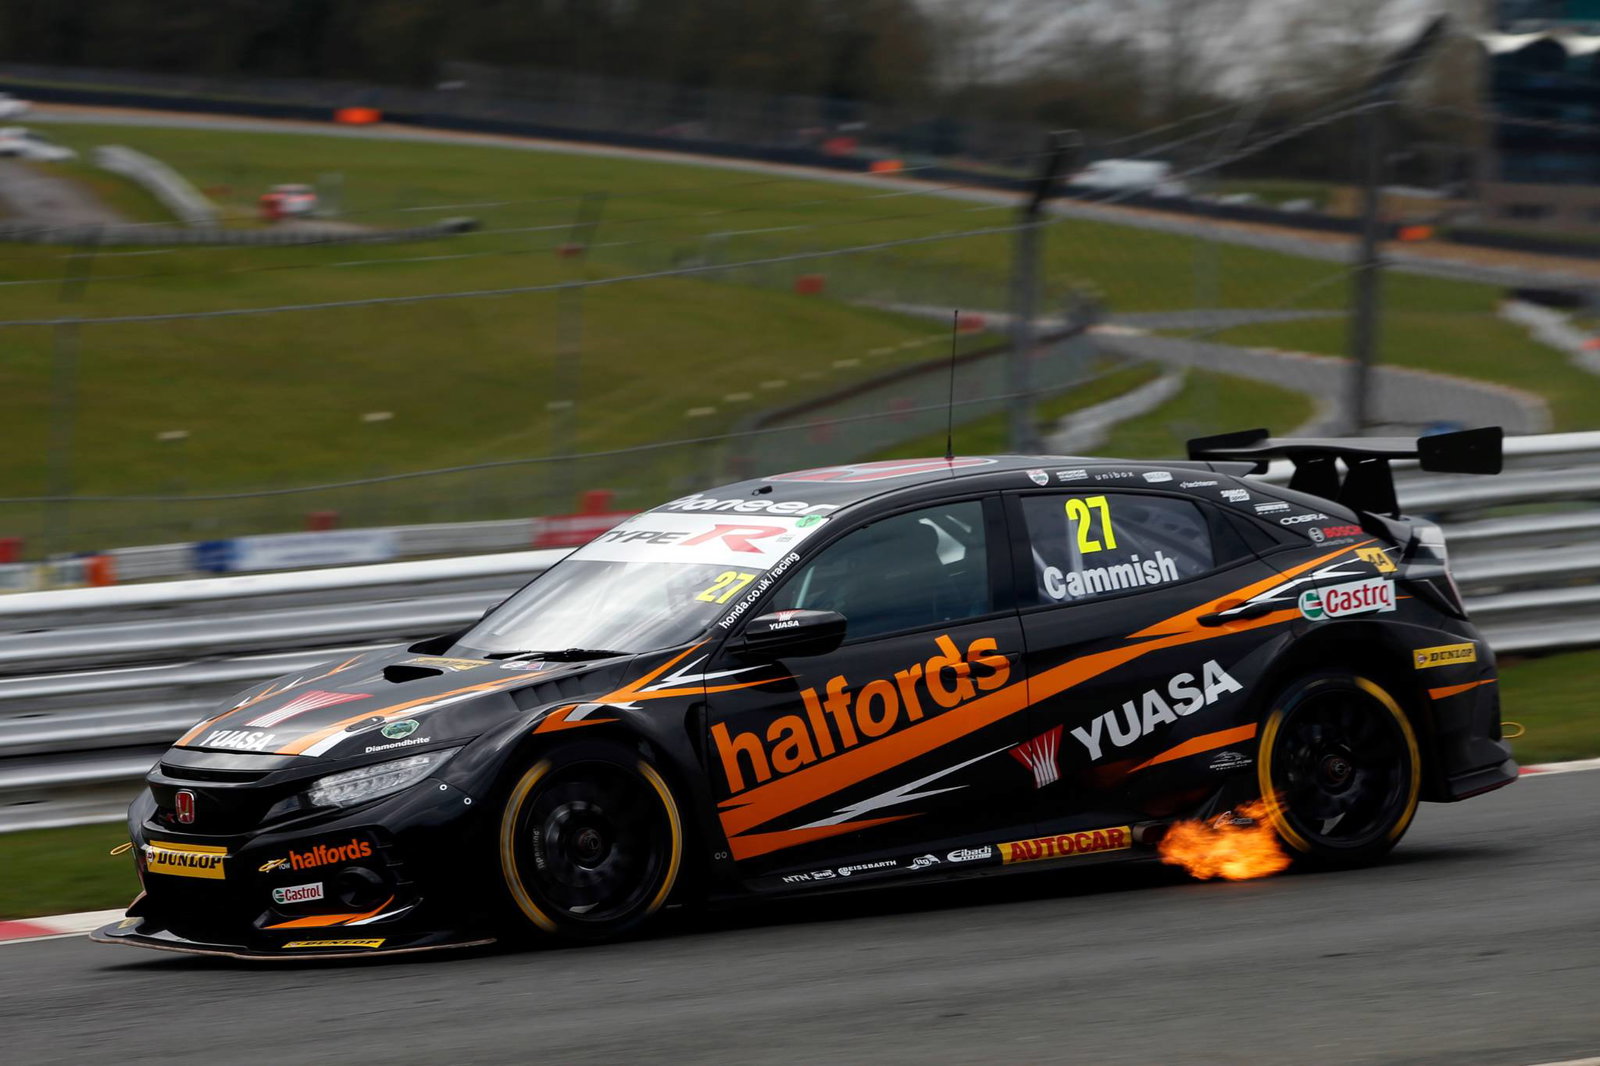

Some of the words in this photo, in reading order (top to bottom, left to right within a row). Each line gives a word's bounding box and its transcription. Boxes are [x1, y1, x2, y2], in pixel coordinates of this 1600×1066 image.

[1094, 471, 1134, 480] unibox
[667, 493, 840, 515] ioneer
[1064, 495, 1117, 554] 27
[1280, 513, 1329, 525] COBRA
[677, 523, 765, 554] R
[1367, 553, 1389, 566] AA
[1043, 551, 1179, 600] Cammish
[695, 570, 756, 604] 27
[719, 551, 800, 630] honda.co.uk/racing
[1326, 583, 1391, 613] Castro
[769, 620, 799, 631] YUASA
[1430, 648, 1473, 662] DUNLOP
[711, 635, 1011, 793] halfords
[1071, 660, 1243, 761] YUASA
[199, 731, 276, 751] YUASA
[365, 737, 430, 753] Diamondbrite
[289, 839, 372, 870] halfords
[947, 846, 992, 862] Eibach
[1009, 828, 1127, 862] AUTOCAR
[157, 851, 222, 869] DUNLOP
[841, 860, 897, 873] BEISSBARTH
[782, 874, 811, 883] NTN
[285, 885, 322, 901] Castrol
